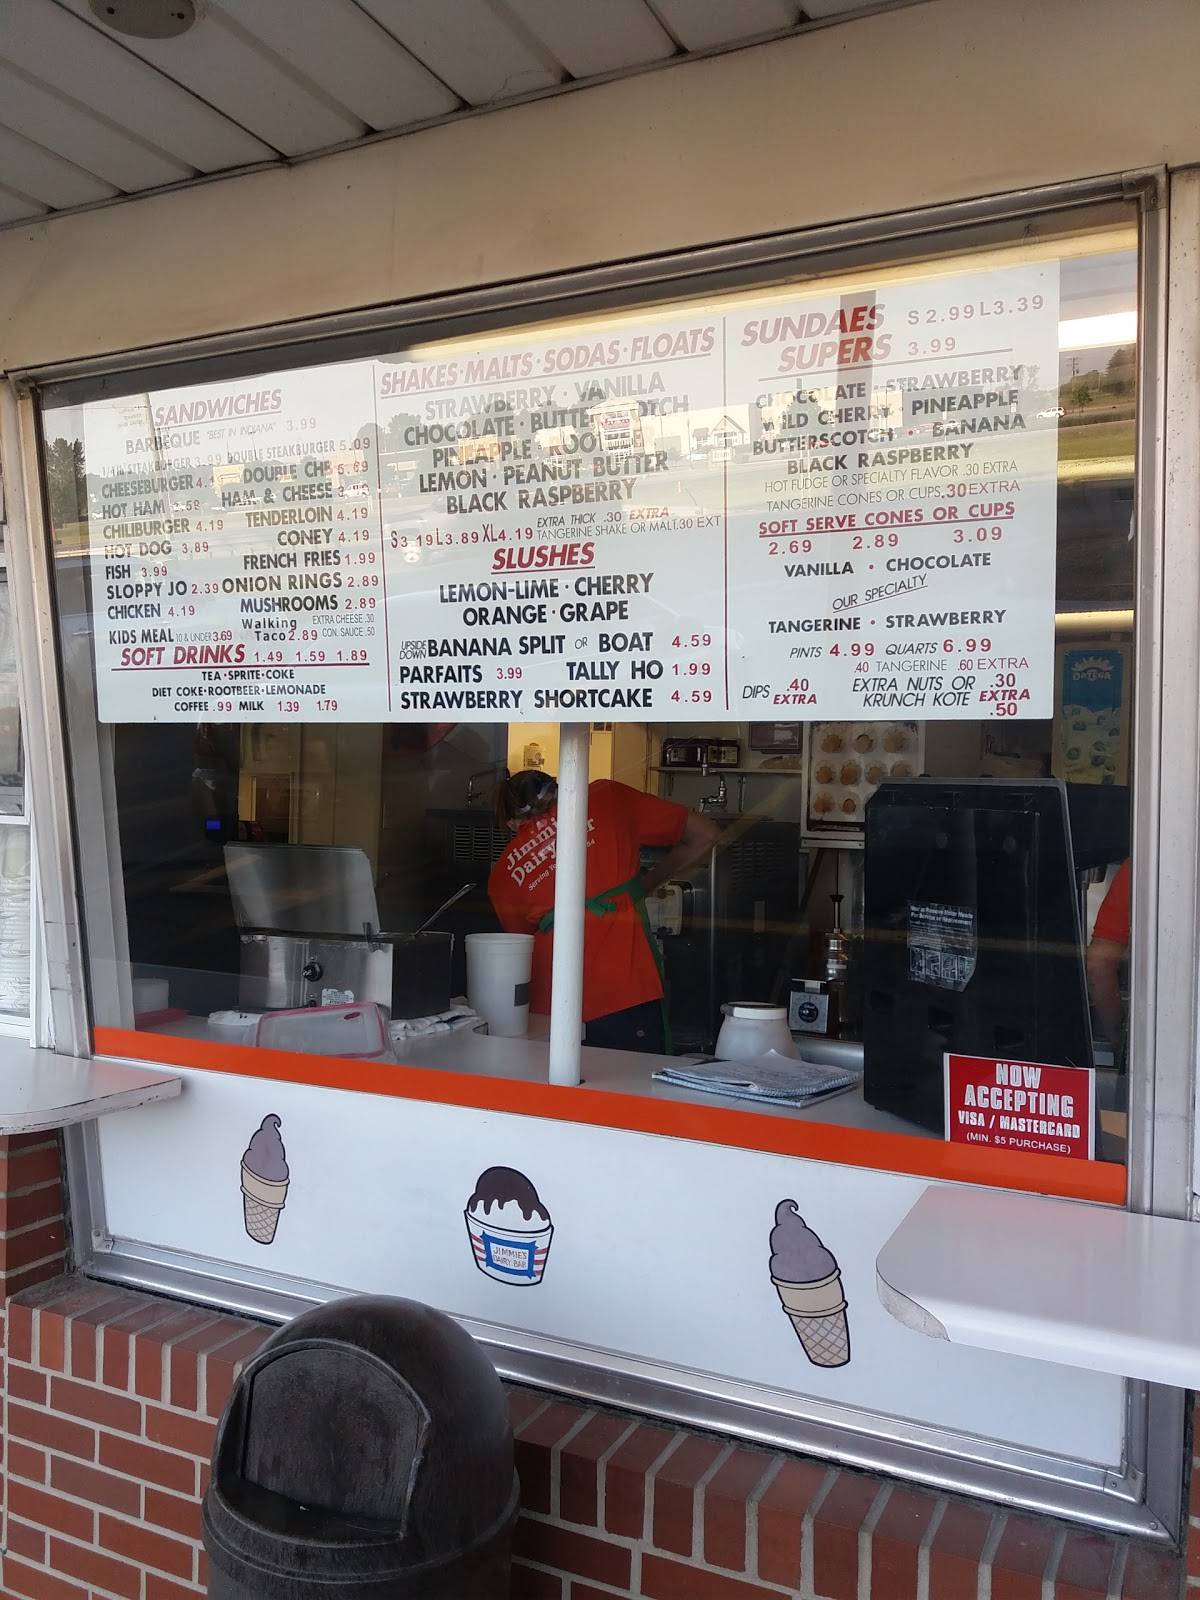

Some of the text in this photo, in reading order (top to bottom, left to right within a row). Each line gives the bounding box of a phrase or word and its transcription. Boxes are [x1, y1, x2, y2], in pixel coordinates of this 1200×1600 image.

[741, 303, 886, 346] SUNDAES
[381, 327, 716, 396] SHAKES MALTS SODAS FLOATS
[777, 333, 956, 372] SUPERS 3.99
[886, 364, 1023, 393] STRAWBERRY
[425, 372, 665, 420] STRAWBERRY VANILLA
[911, 389, 1019, 415] PINEAPPLE
[155, 389, 282, 426] SANDWICHES
[286, 418, 317, 430] 3.99
[404, 415, 514, 446] CHOCOLATE
[339, 437, 371, 452] 5.09
[787, 443, 973, 476] BLACK RASPBERRY
[102, 475, 194, 498] CHEESEBURGER
[419, 461, 580, 493] LEMON PEANUT
[765, 460, 1018, 493] HOT FUDGE OR SPECIALTY FLAVOR EXTRA
[447, 479, 637, 514] BLACK RASPBERRY
[767, 480, 1020, 511] TANGERINE CONES OR EXTRA
[102, 500, 166, 519] HOT HAM
[759, 502, 1015, 535] SOFT SERVE CONES OR CUPS
[103, 507, 368, 539] CHILIBURGER 4.19 TENDERLOIN 4.19
[537, 522, 646, 540] TANGERINE SHAKE OR
[538, 513, 597, 528] EXTRA THICK
[277, 528, 369, 546] CONEY 4.19
[768, 526, 1003, 555] 2.69 2.89 3.09
[140, 540, 209, 556] DOG 3.89
[492, 543, 595, 570] SLUSHES
[244, 550, 375, 570] FRENCH FRIES 1.99
[784, 552, 991, 577] VANILLA CHOCOLATE
[105, 565, 168, 579] FISH 3.99
[107, 580, 219, 599] SLOPPY JO 2.39
[222, 573, 378, 594] ONION RINGS 2.89
[440, 573, 654, 604] LEMON-LIME CHERRY
[832, 574, 927, 611] OUR SPECIALTY
[108, 604, 195, 620] CHICKEN 4.19
[240, 595, 376, 613] MUSHROOMS 2.89
[462, 601, 628, 626] ORANGE GRAPE
[242, 617, 297, 632] Walking
[312, 614, 363, 625] EXTRA CHEESE
[769, 610, 1006, 634] TANGERINE STRAWBERRY
[109, 628, 232, 644] KIDS MEAL 3.69
[255, 630, 318, 642] Taco 2.89
[340, 627, 363, 637] SAUCE
[121, 643, 367, 666] SOFT DRINKS 1.49 1.59 1.89
[399, 650, 427, 660] DOWN
[401, 632, 712, 658] UPSIDE BANANA SPLIT OR BOAT 4.59
[789, 638, 991, 659] PINTS 4.99 QUARTS 6.99
[202, 670, 295, 680] TEA SPRITE COKE
[400, 660, 711, 684] PARFAITS 3.99 TALLY HO 1.99
[876, 658, 1029, 672] TANGERINE EXTRA
[152, 685, 326, 697] DIET COKE ROOTBEER LEMONADE
[742, 686, 770, 699] DIPS
[852, 673, 1015, 692] EXTRA NUTS OR .30
[174, 700, 337, 712] COFFEE .99 MILK 1.39 1.79
[401, 688, 712, 710] STRAWBERRY SHORTCAKE 4.59
[773, 694, 817, 705] EXTRA
[863, 689, 1030, 707] KRUNCH KOTE EXTRA
[989, 703, 1017, 717] .50
[996, 1063, 1041, 1089] NOW
[964, 1084, 1074, 1118] ACCEPTING
[958, 1110, 1080, 1138] VISA / MASTERCARD
[966, 1132, 1071, 1154] (MIN. $5 PURCHASE)
[493, 1247, 527, 1260] JIMMIE'S
[513, 1260, 527, 1268] BAR
